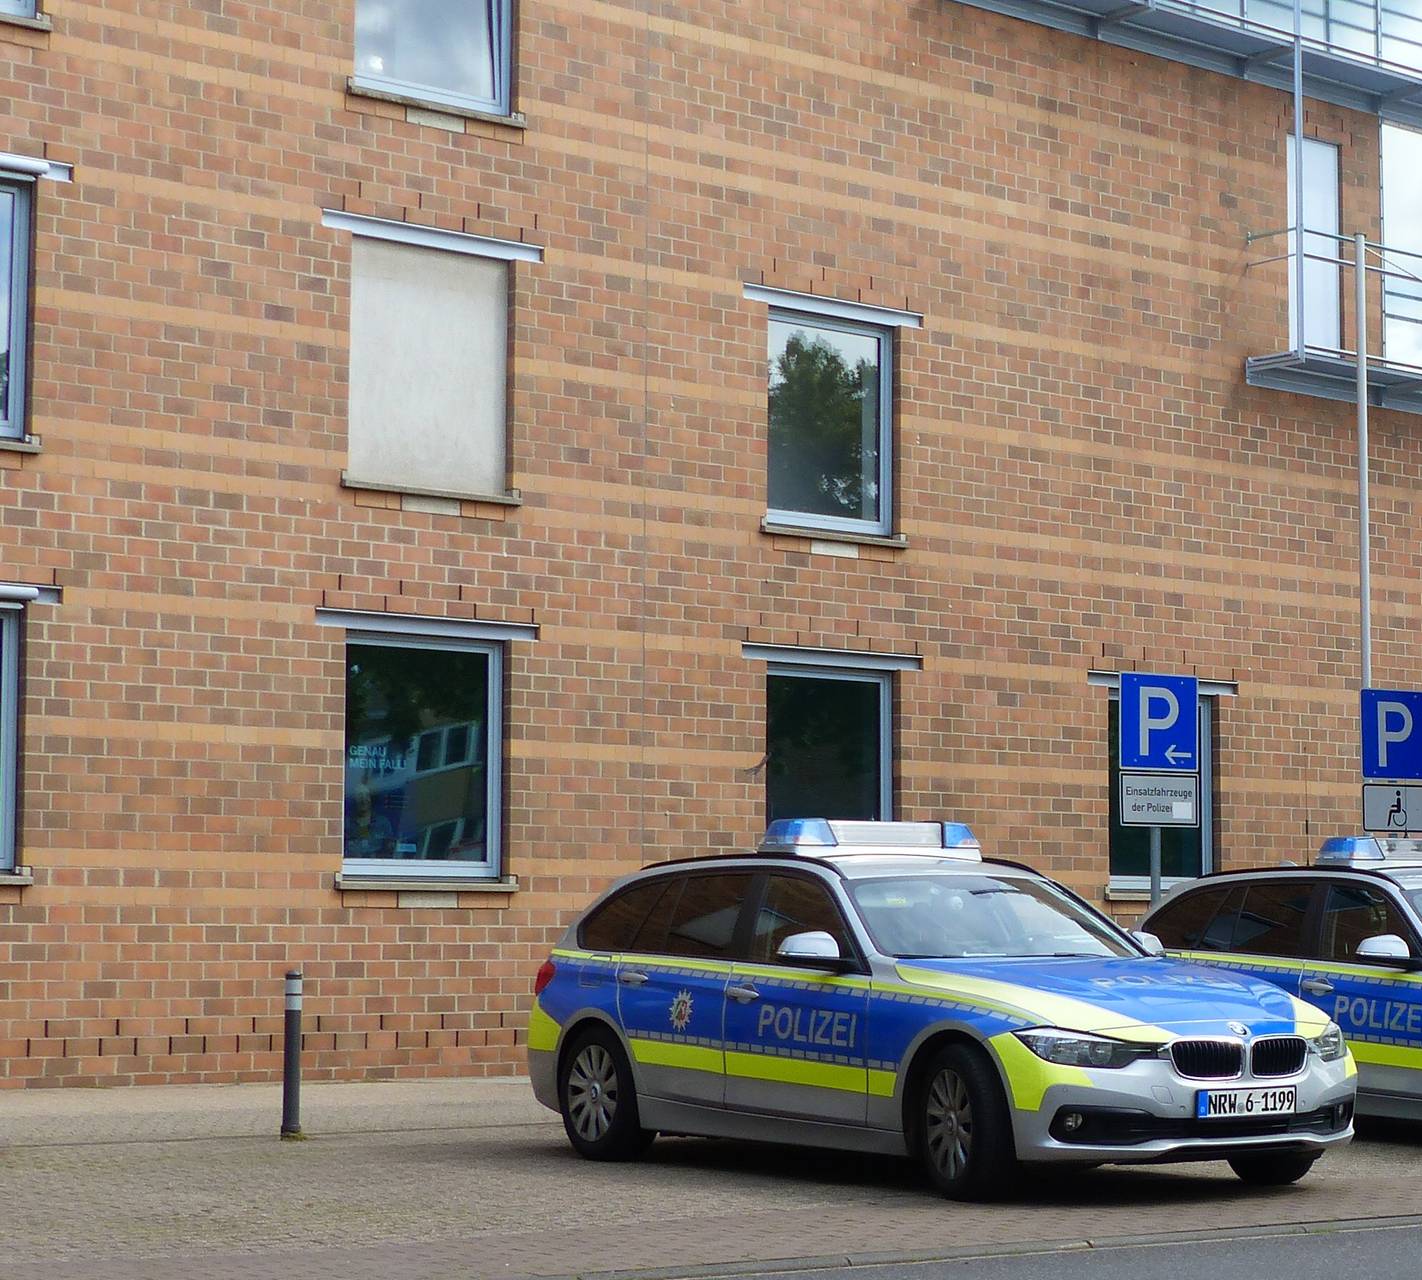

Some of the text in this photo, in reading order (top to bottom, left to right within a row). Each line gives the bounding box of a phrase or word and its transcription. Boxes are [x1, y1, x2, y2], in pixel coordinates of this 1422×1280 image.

[1139, 686, 1179, 756] P
[1377, 701, 1413, 767] P
[350, 745, 386, 756] GENAU
[350, 758, 376, 769] MEIN
[1125, 786, 1193, 799] Einsatzfahrzeuge
[1131, 803, 1145, 812] der
[758, 1004, 857, 1048] POLIZEI
[1208, 1094, 1238, 1115] NRW
[1245, 1090, 1294, 1113] 6-1199
